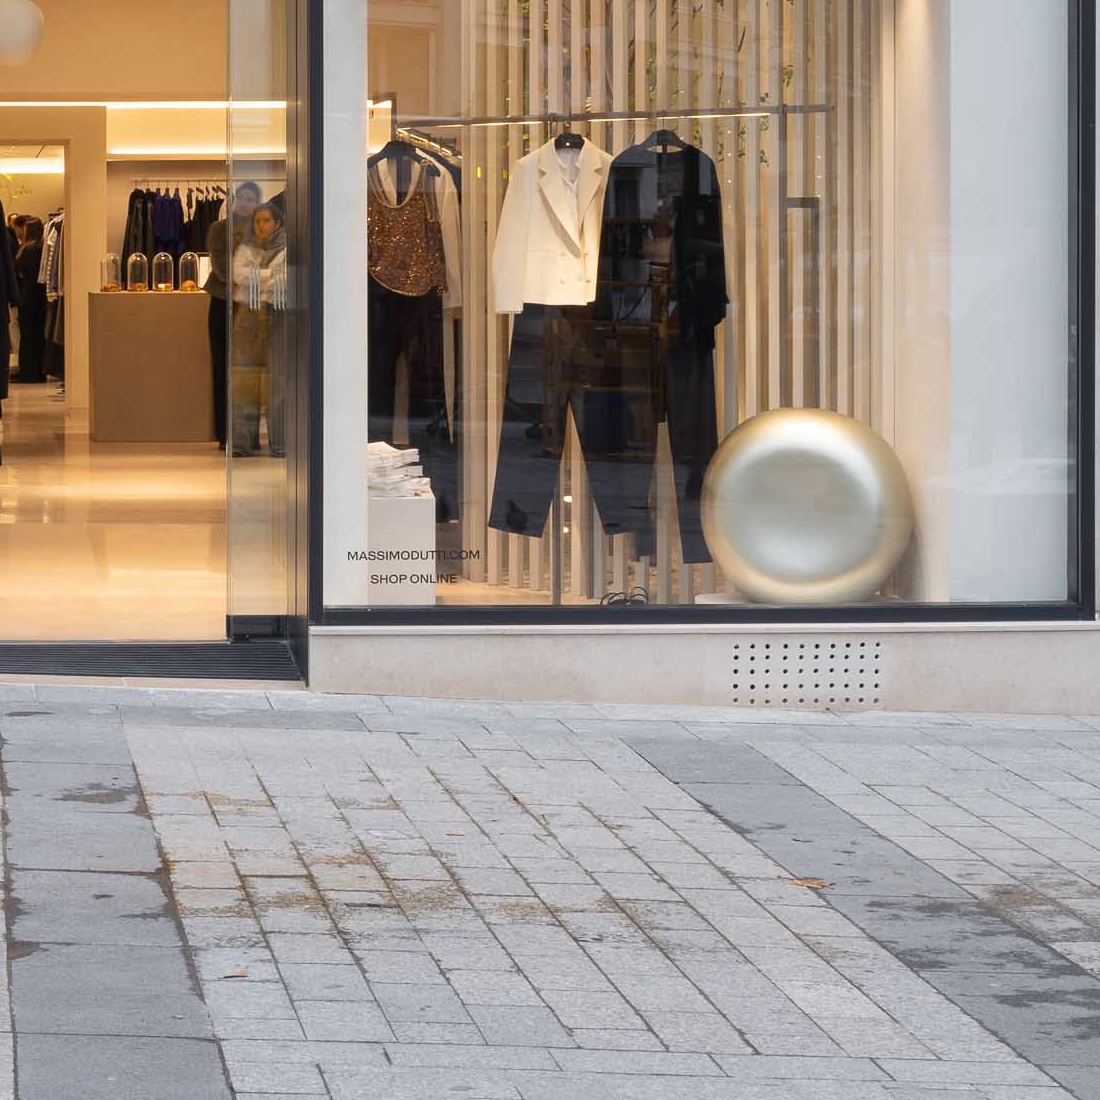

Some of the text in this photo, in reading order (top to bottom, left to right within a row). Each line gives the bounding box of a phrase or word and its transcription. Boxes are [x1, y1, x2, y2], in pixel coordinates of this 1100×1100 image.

[347, 549, 480, 561] MASSIMODUTTI.COM
[370, 573, 458, 585] SHOP ONLINE
